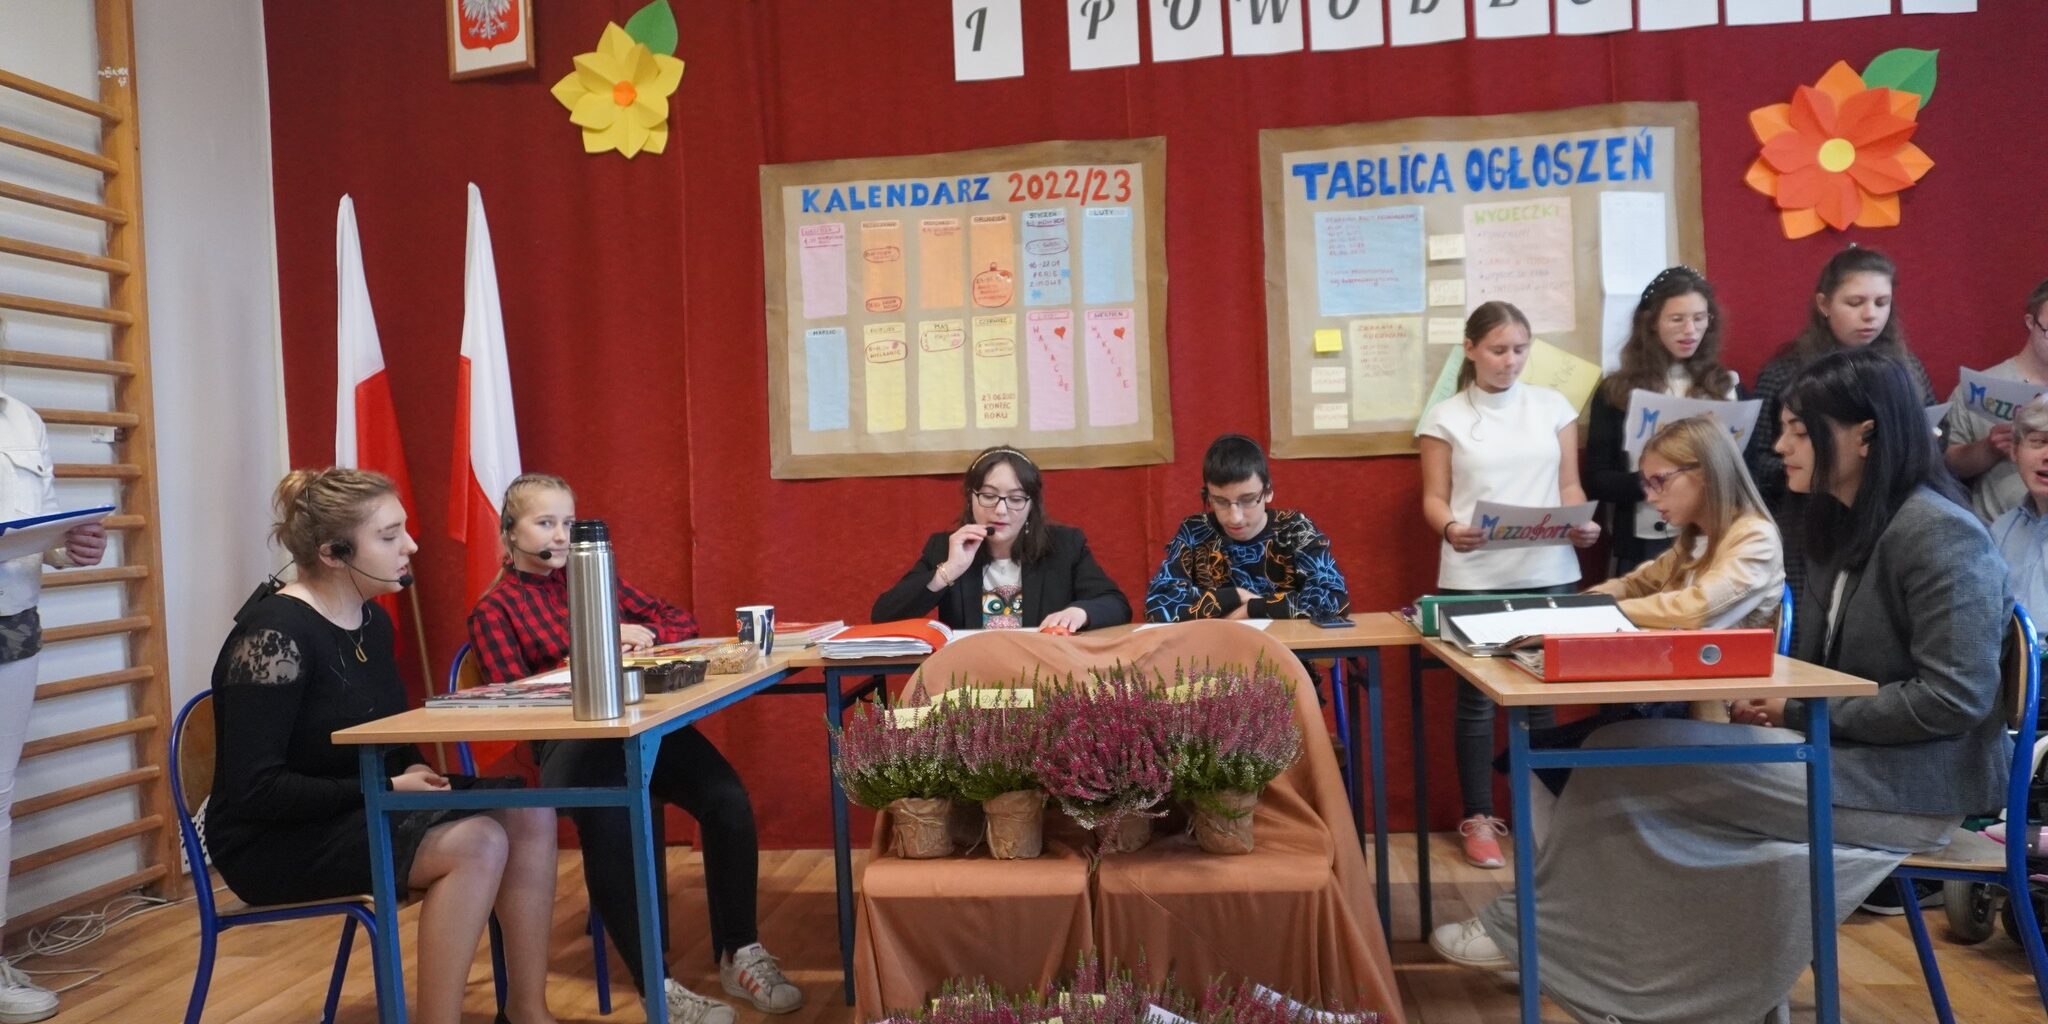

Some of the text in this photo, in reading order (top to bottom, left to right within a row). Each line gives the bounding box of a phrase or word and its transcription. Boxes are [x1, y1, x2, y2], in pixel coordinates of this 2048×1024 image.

[801, 168, 1132, 213] KALENDARZ 2022/23
[1292, 127, 1653, 201] TABLICA OGŁOSZEŃ
